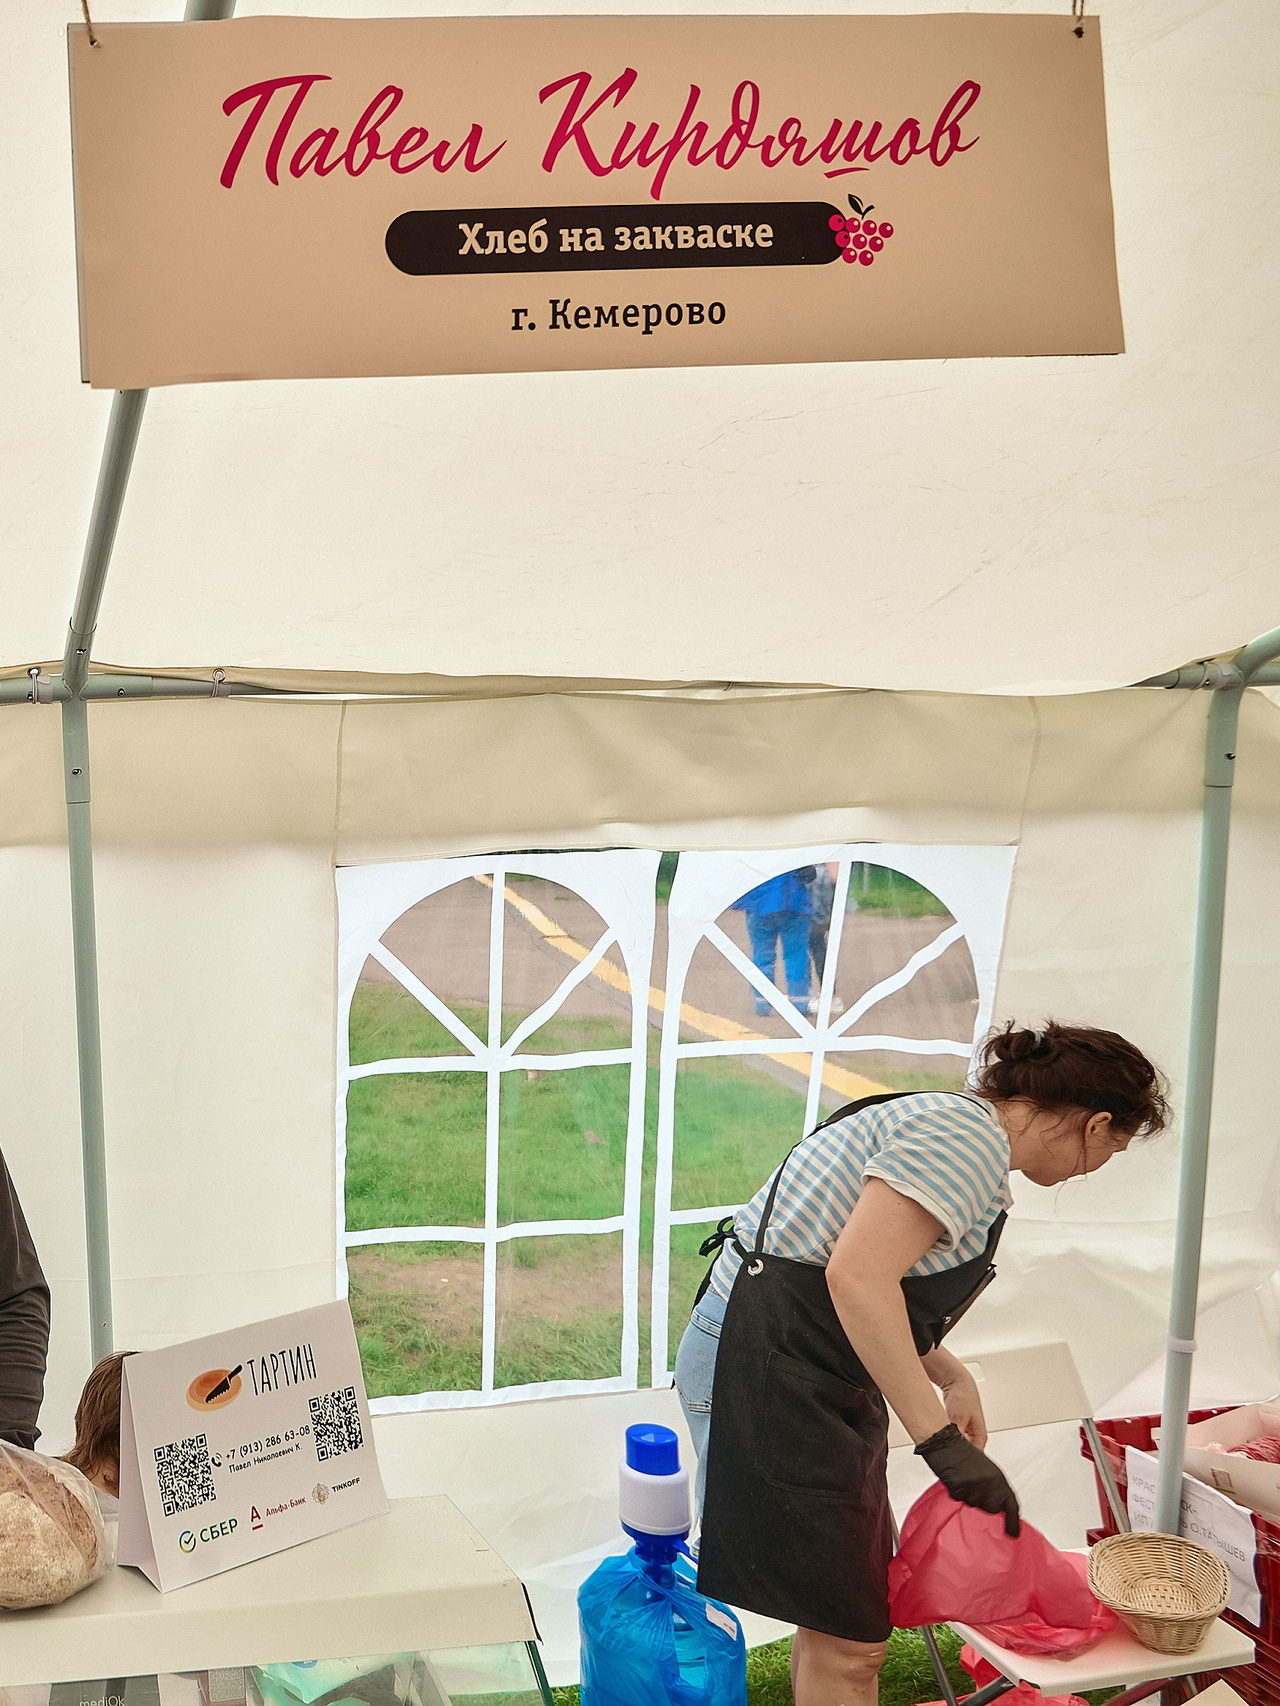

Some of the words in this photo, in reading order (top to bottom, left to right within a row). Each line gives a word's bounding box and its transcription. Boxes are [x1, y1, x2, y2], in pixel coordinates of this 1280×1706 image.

[219, 74, 507, 189] Павел
[538, 67, 982, 201] Кирдяшов
[458, 218, 548, 255] Хлеб
[559, 226, 604, 252] на
[614, 223, 774, 250] закваске
[511, 307, 536, 331] г.
[549, 298, 726, 335] Кемерово
[247, 1343, 317, 1396] ТАРТИН
[225, 1449, 236, 1460] +7
[240, 1441, 263, 1458] (913)
[265, 1434, 282, 1447] 286
[284, 1425, 310, 1441] 63-08
[228, 1461, 252, 1473] Павел
[253, 1447, 294, 1465] Николаевич
[332, 1477, 361, 1493] TINKOFF
[266, 1497, 307, 1517] Альфа-Банк
[199, 1518, 238, 1543] СБЕР
